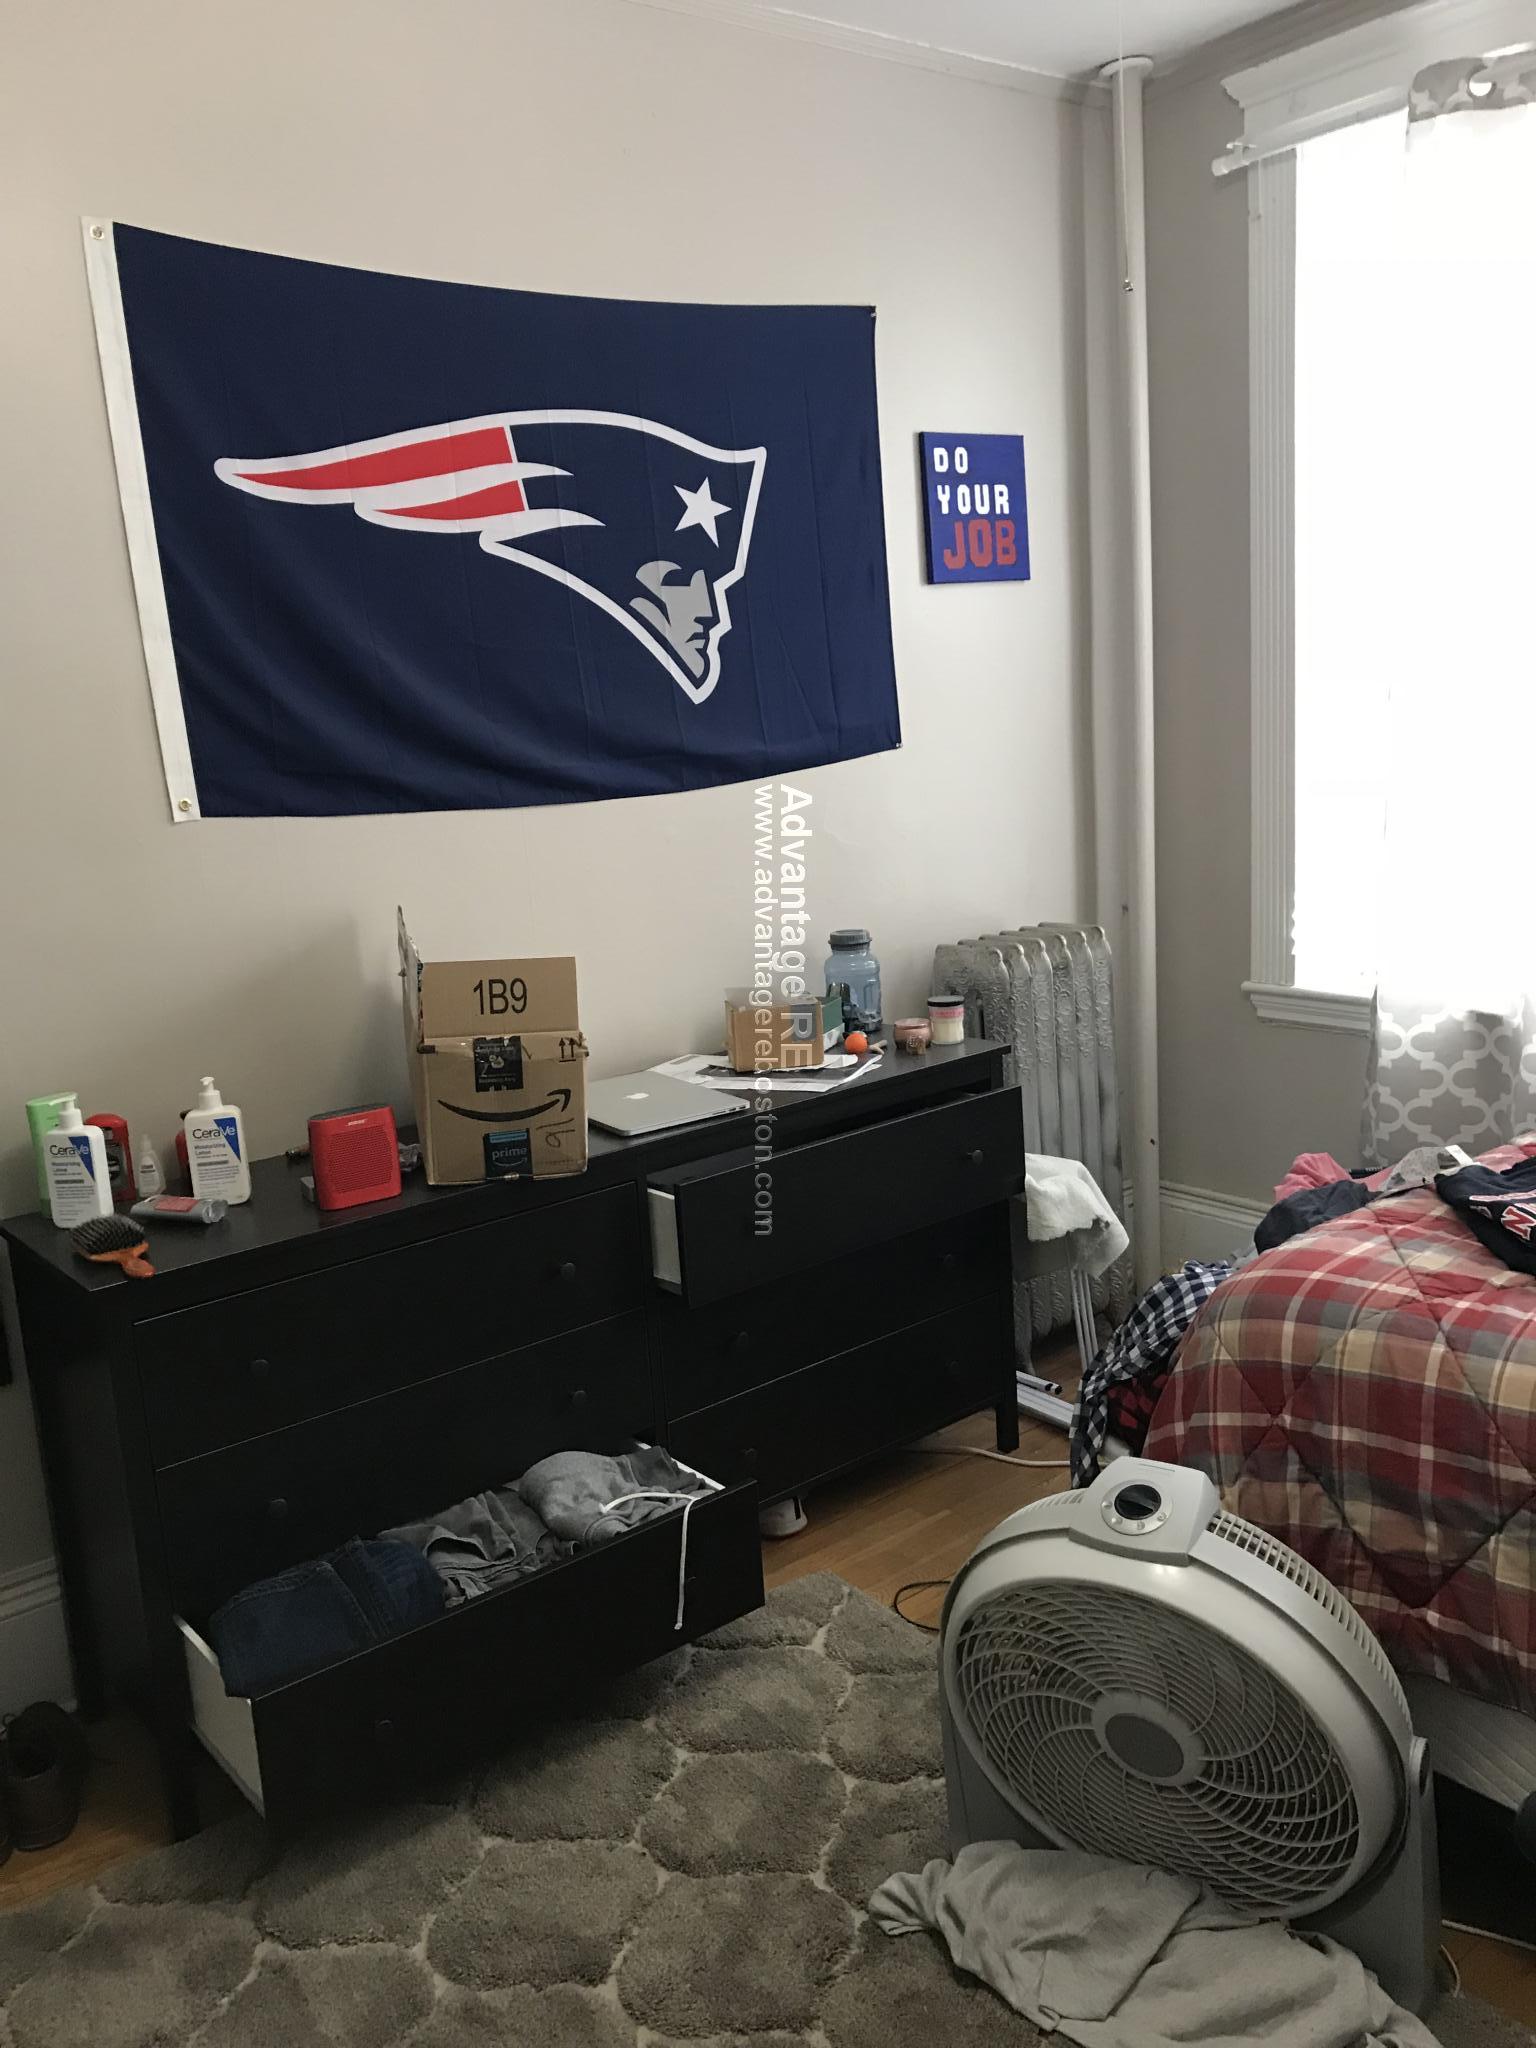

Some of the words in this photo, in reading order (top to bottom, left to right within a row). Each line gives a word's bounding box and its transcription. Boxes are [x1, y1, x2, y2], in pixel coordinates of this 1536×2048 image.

[933, 447, 968, 473] DO
[937, 484, 1010, 514] YOUR
[943, 519, 1017, 569] JOB
[473, 978, 528, 1015] 1B9
[192, 1126, 236, 1139] CeraVe
[49, 1143, 90, 1156] CeraVe
[492, 1147, 527, 1160] prime
